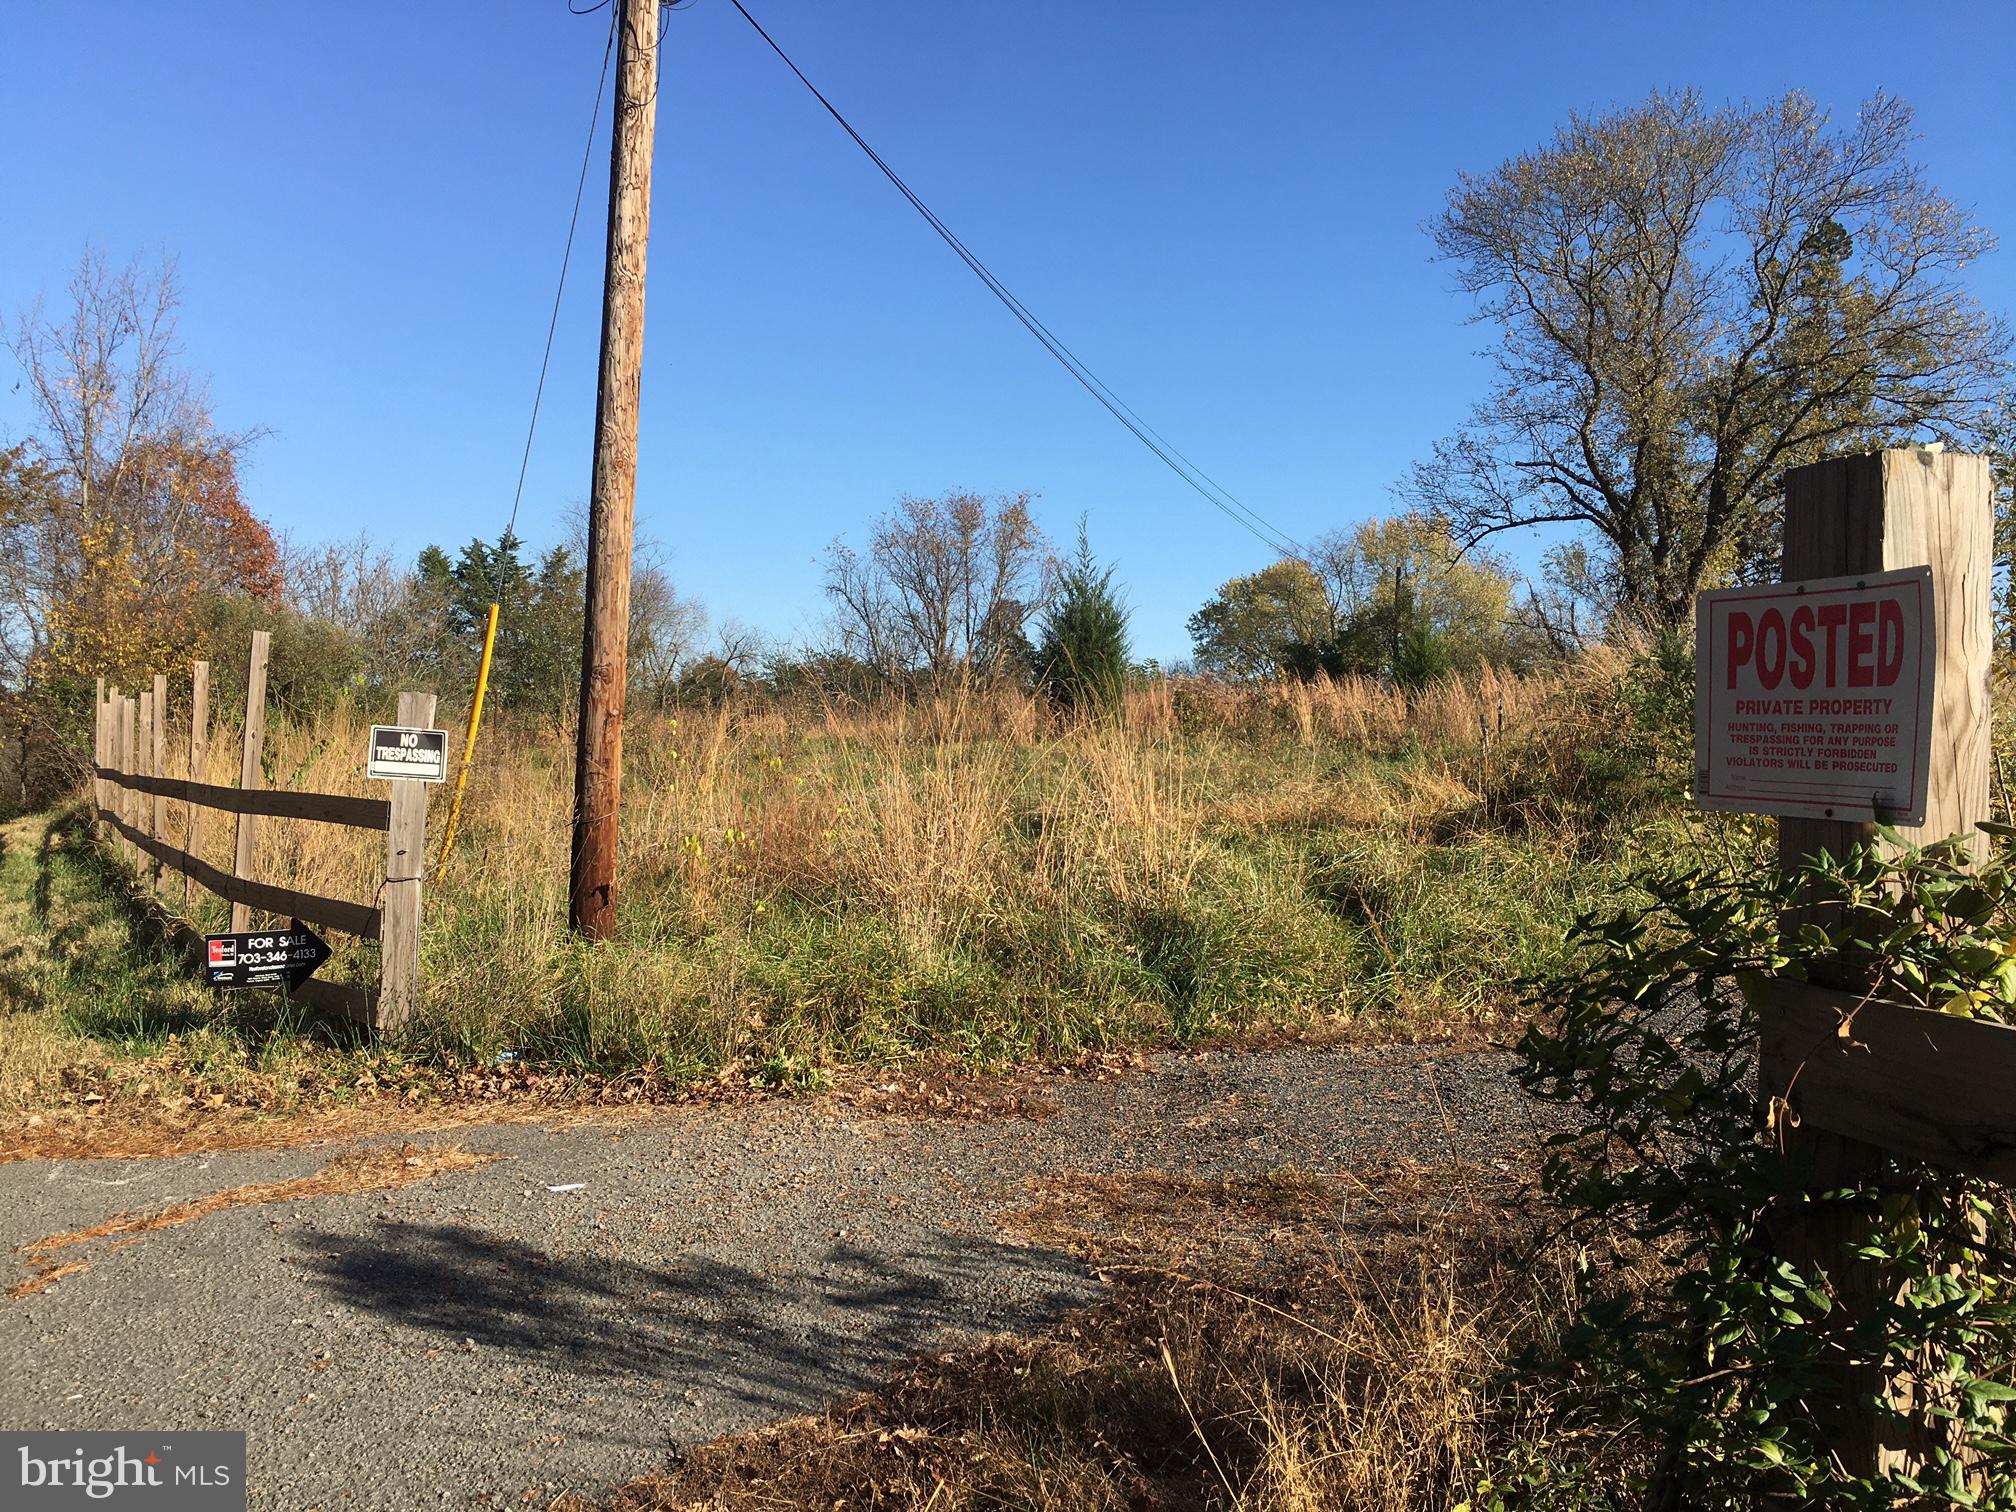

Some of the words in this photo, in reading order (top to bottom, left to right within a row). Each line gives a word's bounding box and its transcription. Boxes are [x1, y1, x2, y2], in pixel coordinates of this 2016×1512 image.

[1727, 599, 1904, 690] POSTED
[1735, 700, 1803, 715] PRIVATE
[1809, 699, 1892, 715] PROPERTY
[1728, 723, 1777, 734] HUNTING,
[1781, 724, 1826, 734] FISHING,
[1830, 724, 1881, 734] TRAPPING
[1885, 724, 1898, 734] OR
[400, 734, 418, 747] NO
[1730, 734, 1800, 745] TRESPASSING
[1803, 736, 1823, 745] FOR
[1827, 736, 1849, 746] ANY
[1853, 736, 1896, 746] PURPOSE
[376, 746, 440, 763] TRESPASSING
[1749, 746, 1759, 755] IS
[1762, 747, 1814, 757] STRICTLY
[1818, 748, 1877, 759] FORBIDDEN
[1726, 757, 1784, 768] VIOLATORS
[1788, 759, 1810, 769] WILL
[1815, 760, 1828, 770] BE
[1832, 762, 1897, 772] PROSECUTED
[248, 938, 273, 949] FOR
[279, 935, 306, 946] SALE
[238, 948, 316, 964] 703-346-4133
